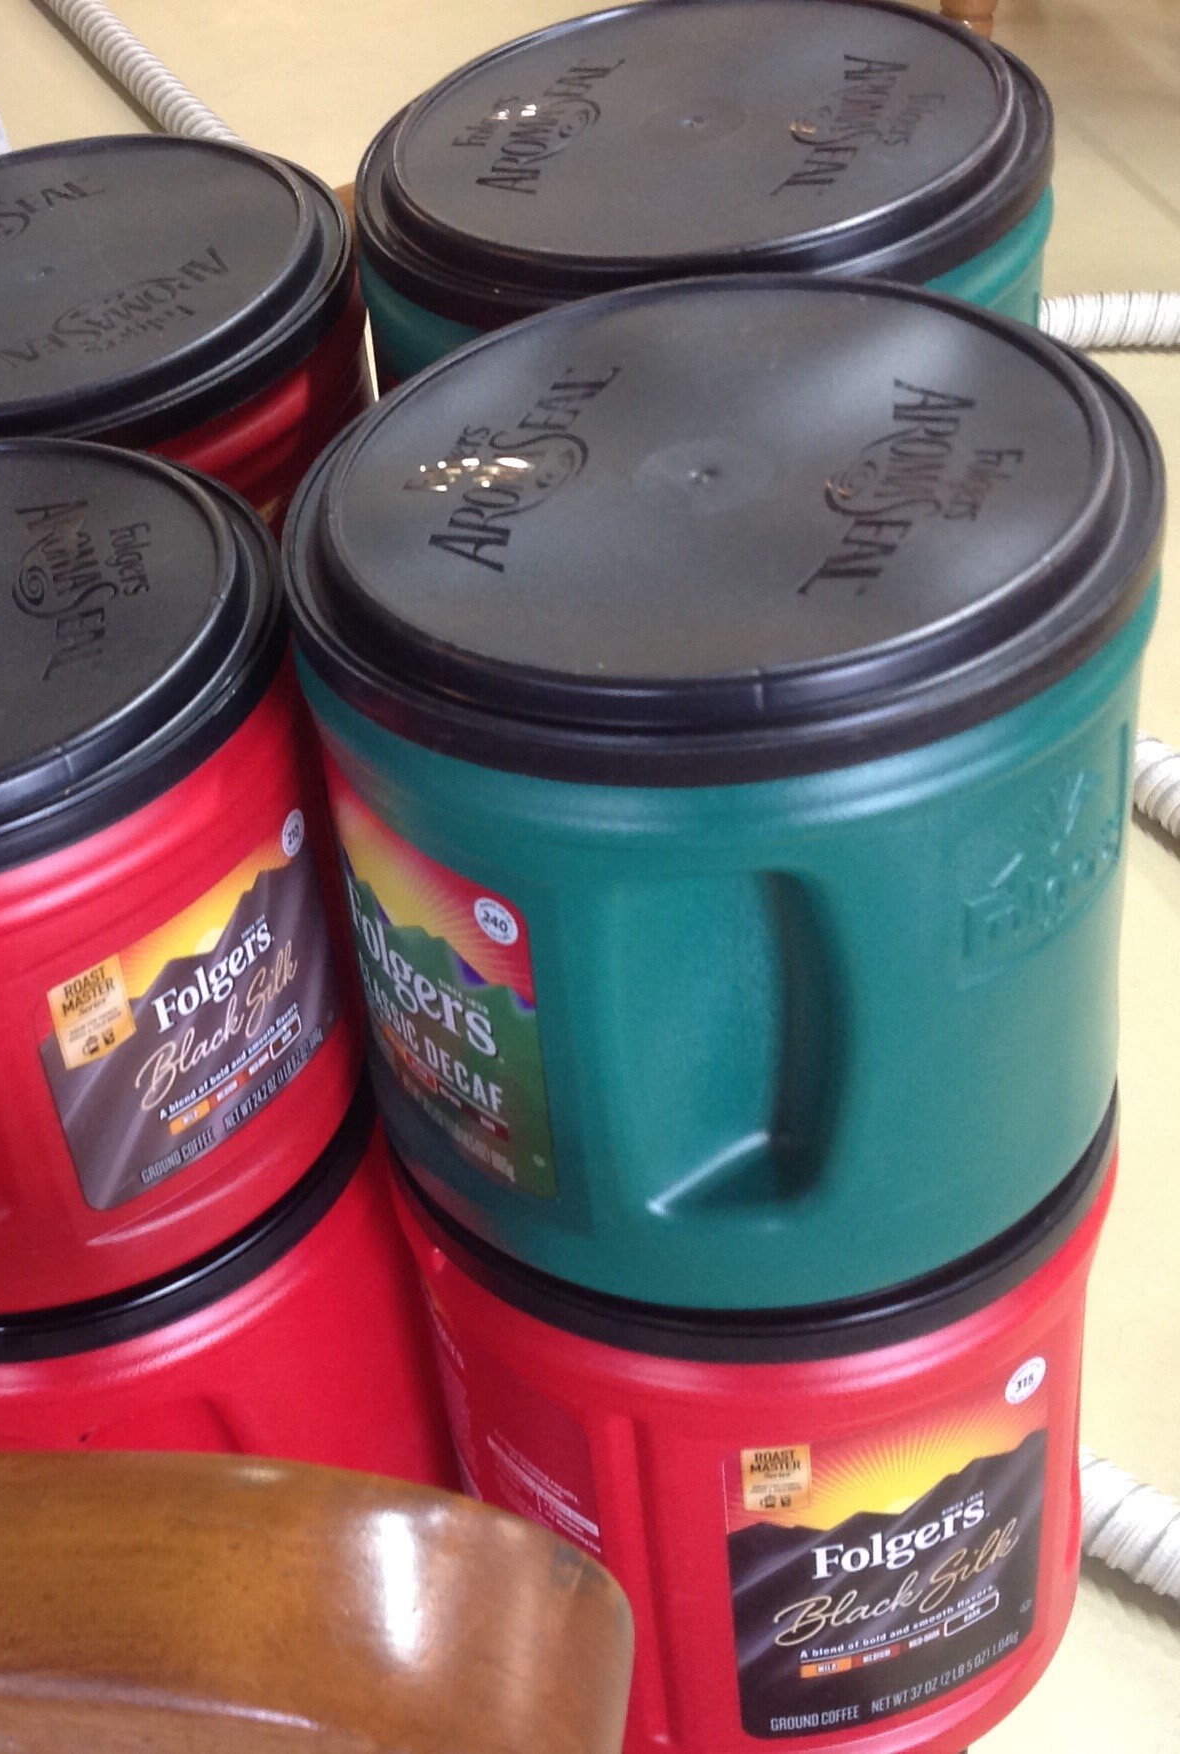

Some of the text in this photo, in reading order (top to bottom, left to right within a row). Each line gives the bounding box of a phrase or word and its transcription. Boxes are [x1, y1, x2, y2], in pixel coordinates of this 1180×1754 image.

[109, 521, 151, 598] Folgers
[482, 909, 508, 933] 240
[61, 976, 116, 1018] MASTER
[64, 964, 106, 1000] ROAST
[151, 921, 271, 1034] Folgers
[346, 874, 498, 1058] Folgers
[134, 940, 298, 1111] Black Silk
[168, 1090, 197, 1114] blend
[197, 1079, 209, 1094] of
[210, 1063, 231, 1083] bold
[231, 1049, 247, 1066] and
[424, 1035, 504, 1114] DECAF
[141, 1153, 182, 1185] GROUND
[181, 1127, 216, 1161] COFFEE
[749, 1460, 801, 1474] MASTER
[753, 1449, 795, 1463] ROAST
[811, 1498, 986, 1582] Folgers
[773, 1516, 1021, 1648] Black Silk
[800, 1585, 994, 1660] A blend of bold and smooth flavors
[770, 1703, 819, 1733] GROUND
[821, 1703, 860, 1726] COFFEE
[870, 1696, 890, 1714] NET
[892, 1690, 909, 1707] WT
[910, 1683, 923, 1701] 37
[924, 1677, 939, 1696] OZ
[952, 1663, 965, 1681] LB
